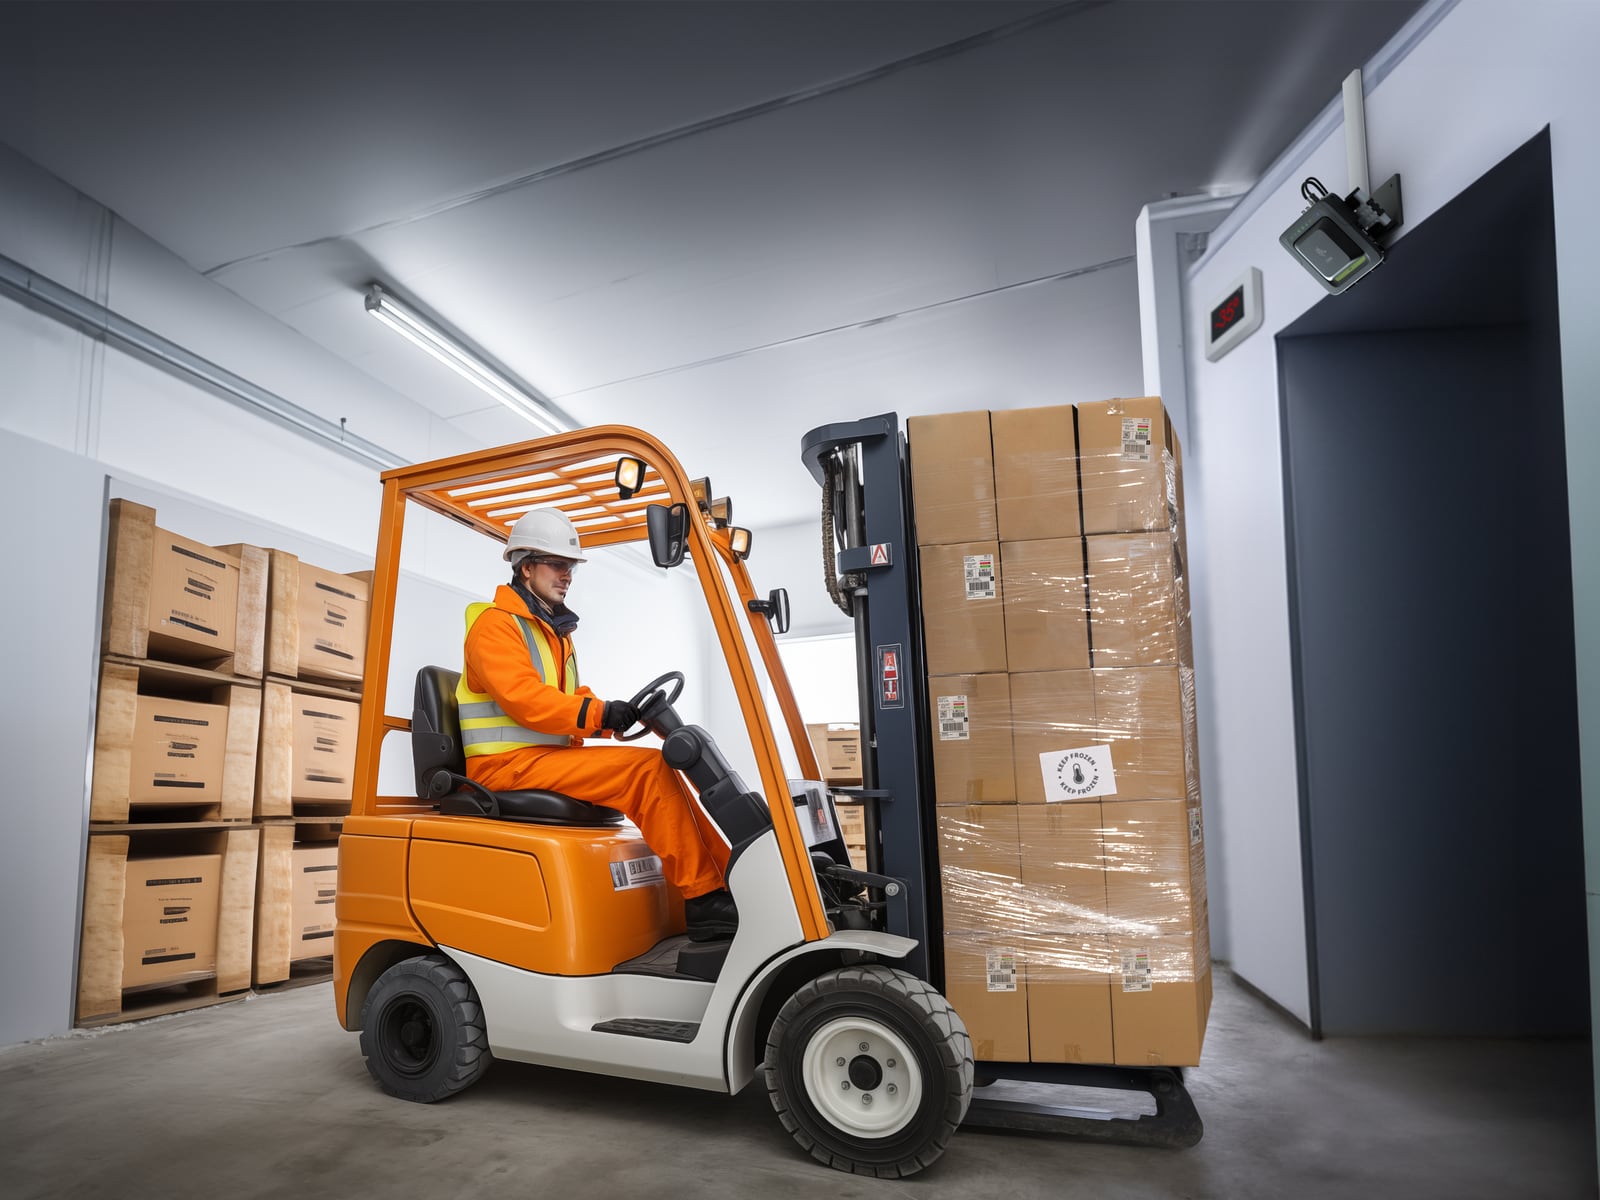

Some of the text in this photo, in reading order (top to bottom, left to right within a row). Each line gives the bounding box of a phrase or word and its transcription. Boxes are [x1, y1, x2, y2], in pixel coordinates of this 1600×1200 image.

[1057, 752, 1096, 772] KEEP FROZEN
[1060, 775, 1099, 795] KEEP FROZEN
